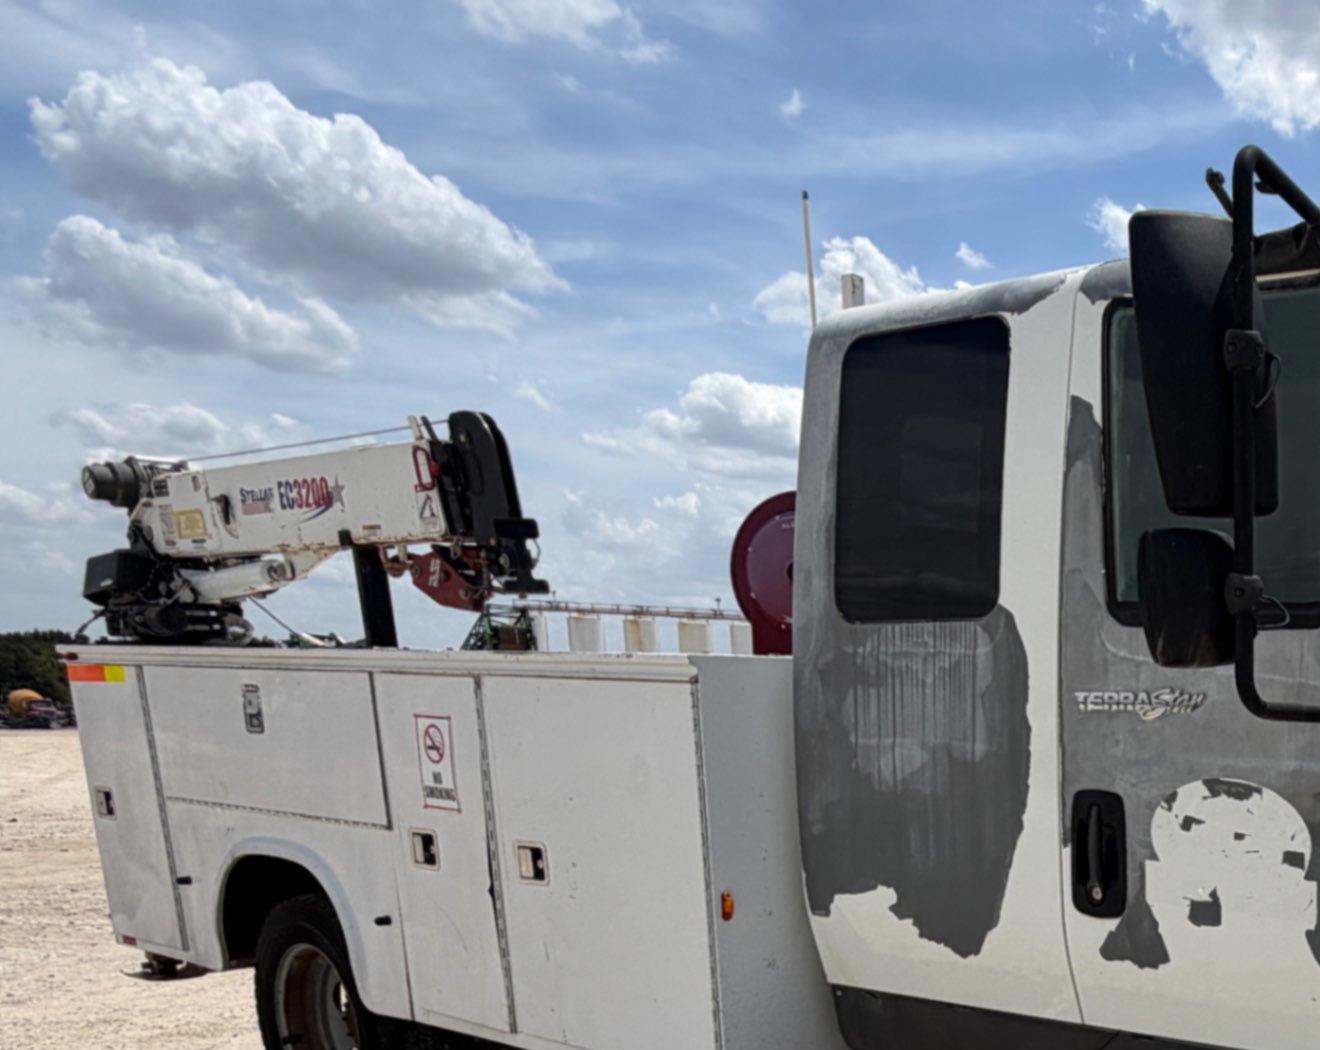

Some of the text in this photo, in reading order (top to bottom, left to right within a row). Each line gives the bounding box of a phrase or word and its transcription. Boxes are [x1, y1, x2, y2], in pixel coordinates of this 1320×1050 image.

[277, 476, 332, 510] EC3200
[432, 771, 443, 785] NO
[424, 785, 456, 802] SMOKING
